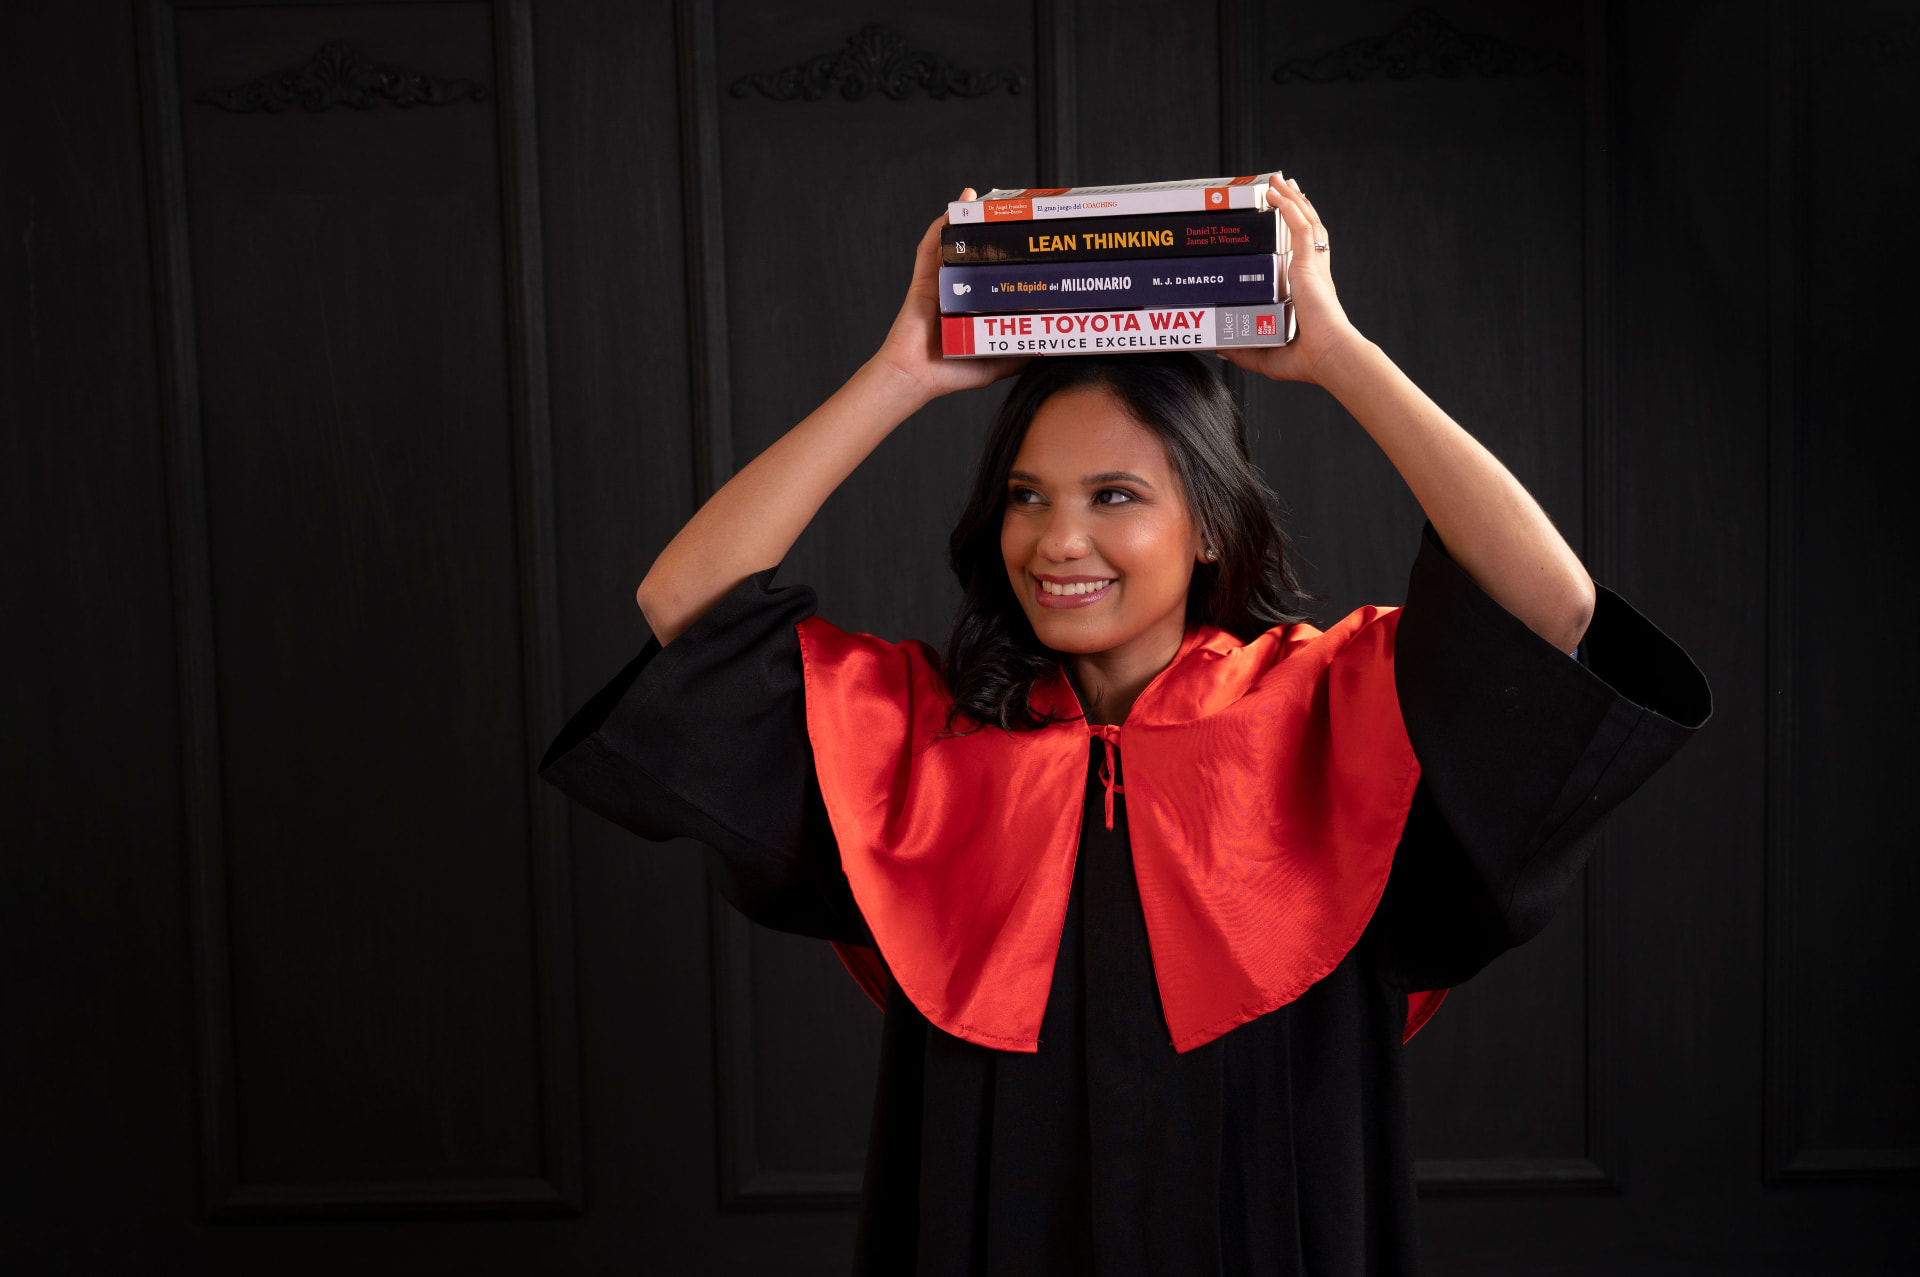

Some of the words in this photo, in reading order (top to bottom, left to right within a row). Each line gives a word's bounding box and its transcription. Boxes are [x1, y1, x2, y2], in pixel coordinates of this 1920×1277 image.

[1057, 204, 1072, 213] juego
[1082, 201, 1118, 209] COACHING
[1186, 226, 1210, 236] Daniel
[1211, 226, 1218, 234] T.
[1219, 226, 1241, 234] Jones
[1028, 234, 1077, 253] LEAN
[1082, 229, 1174, 250] THINKING
[1186, 237, 1209, 246] James
[1210, 236, 1217, 244] P.
[1218, 234, 1250, 244] Womack
[991, 285, 999, 293] La
[1000, 282, 1015, 293] Vía
[1017, 280, 1048, 294] Rápida
[1049, 282, 1059, 291] del
[1061, 276, 1132, 292] MILLONARIO
[1152, 277, 1163, 286] M.
[1164, 277, 1173, 286] J.
[984, 318, 1032, 337] THE
[1040, 313, 1141, 335] TOYOTA
[1149, 310, 1206, 330] WAY
[1223, 311, 1234, 341] Liker
[1241, 314, 1250, 337] Ross
[1257, 325, 1263, 335] Mc
[989, 340, 1009, 351] TO
[1017, 338, 1087, 351] SERVICE
[1095, 334, 1203, 348] EXCELLENCE
